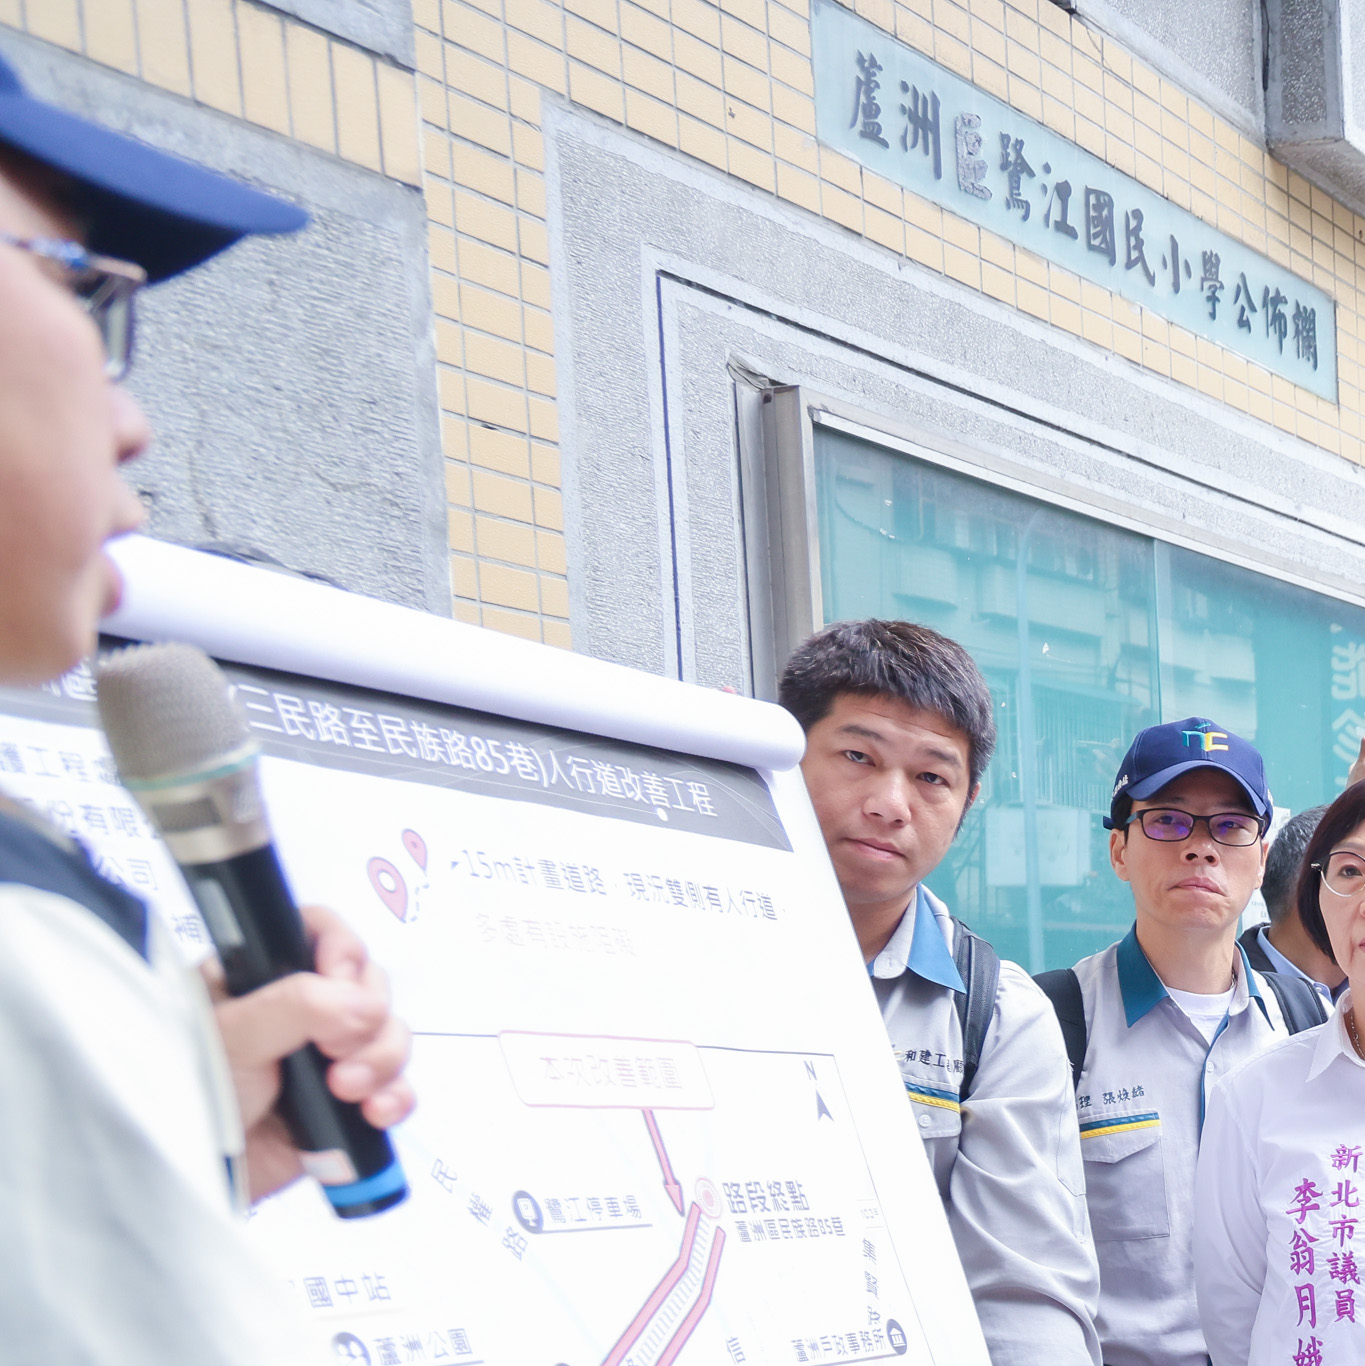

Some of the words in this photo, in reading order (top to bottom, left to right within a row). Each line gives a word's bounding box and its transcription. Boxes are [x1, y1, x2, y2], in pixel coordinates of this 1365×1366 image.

[849, 50, 1318, 371] 蘆洲區鷺江國民小學公佈欄
[804, 1060, 817, 1081] N
[722, 1180, 810, 1214] 路段終點
[1326, 1143, 1363, 1324] 新北市議員
